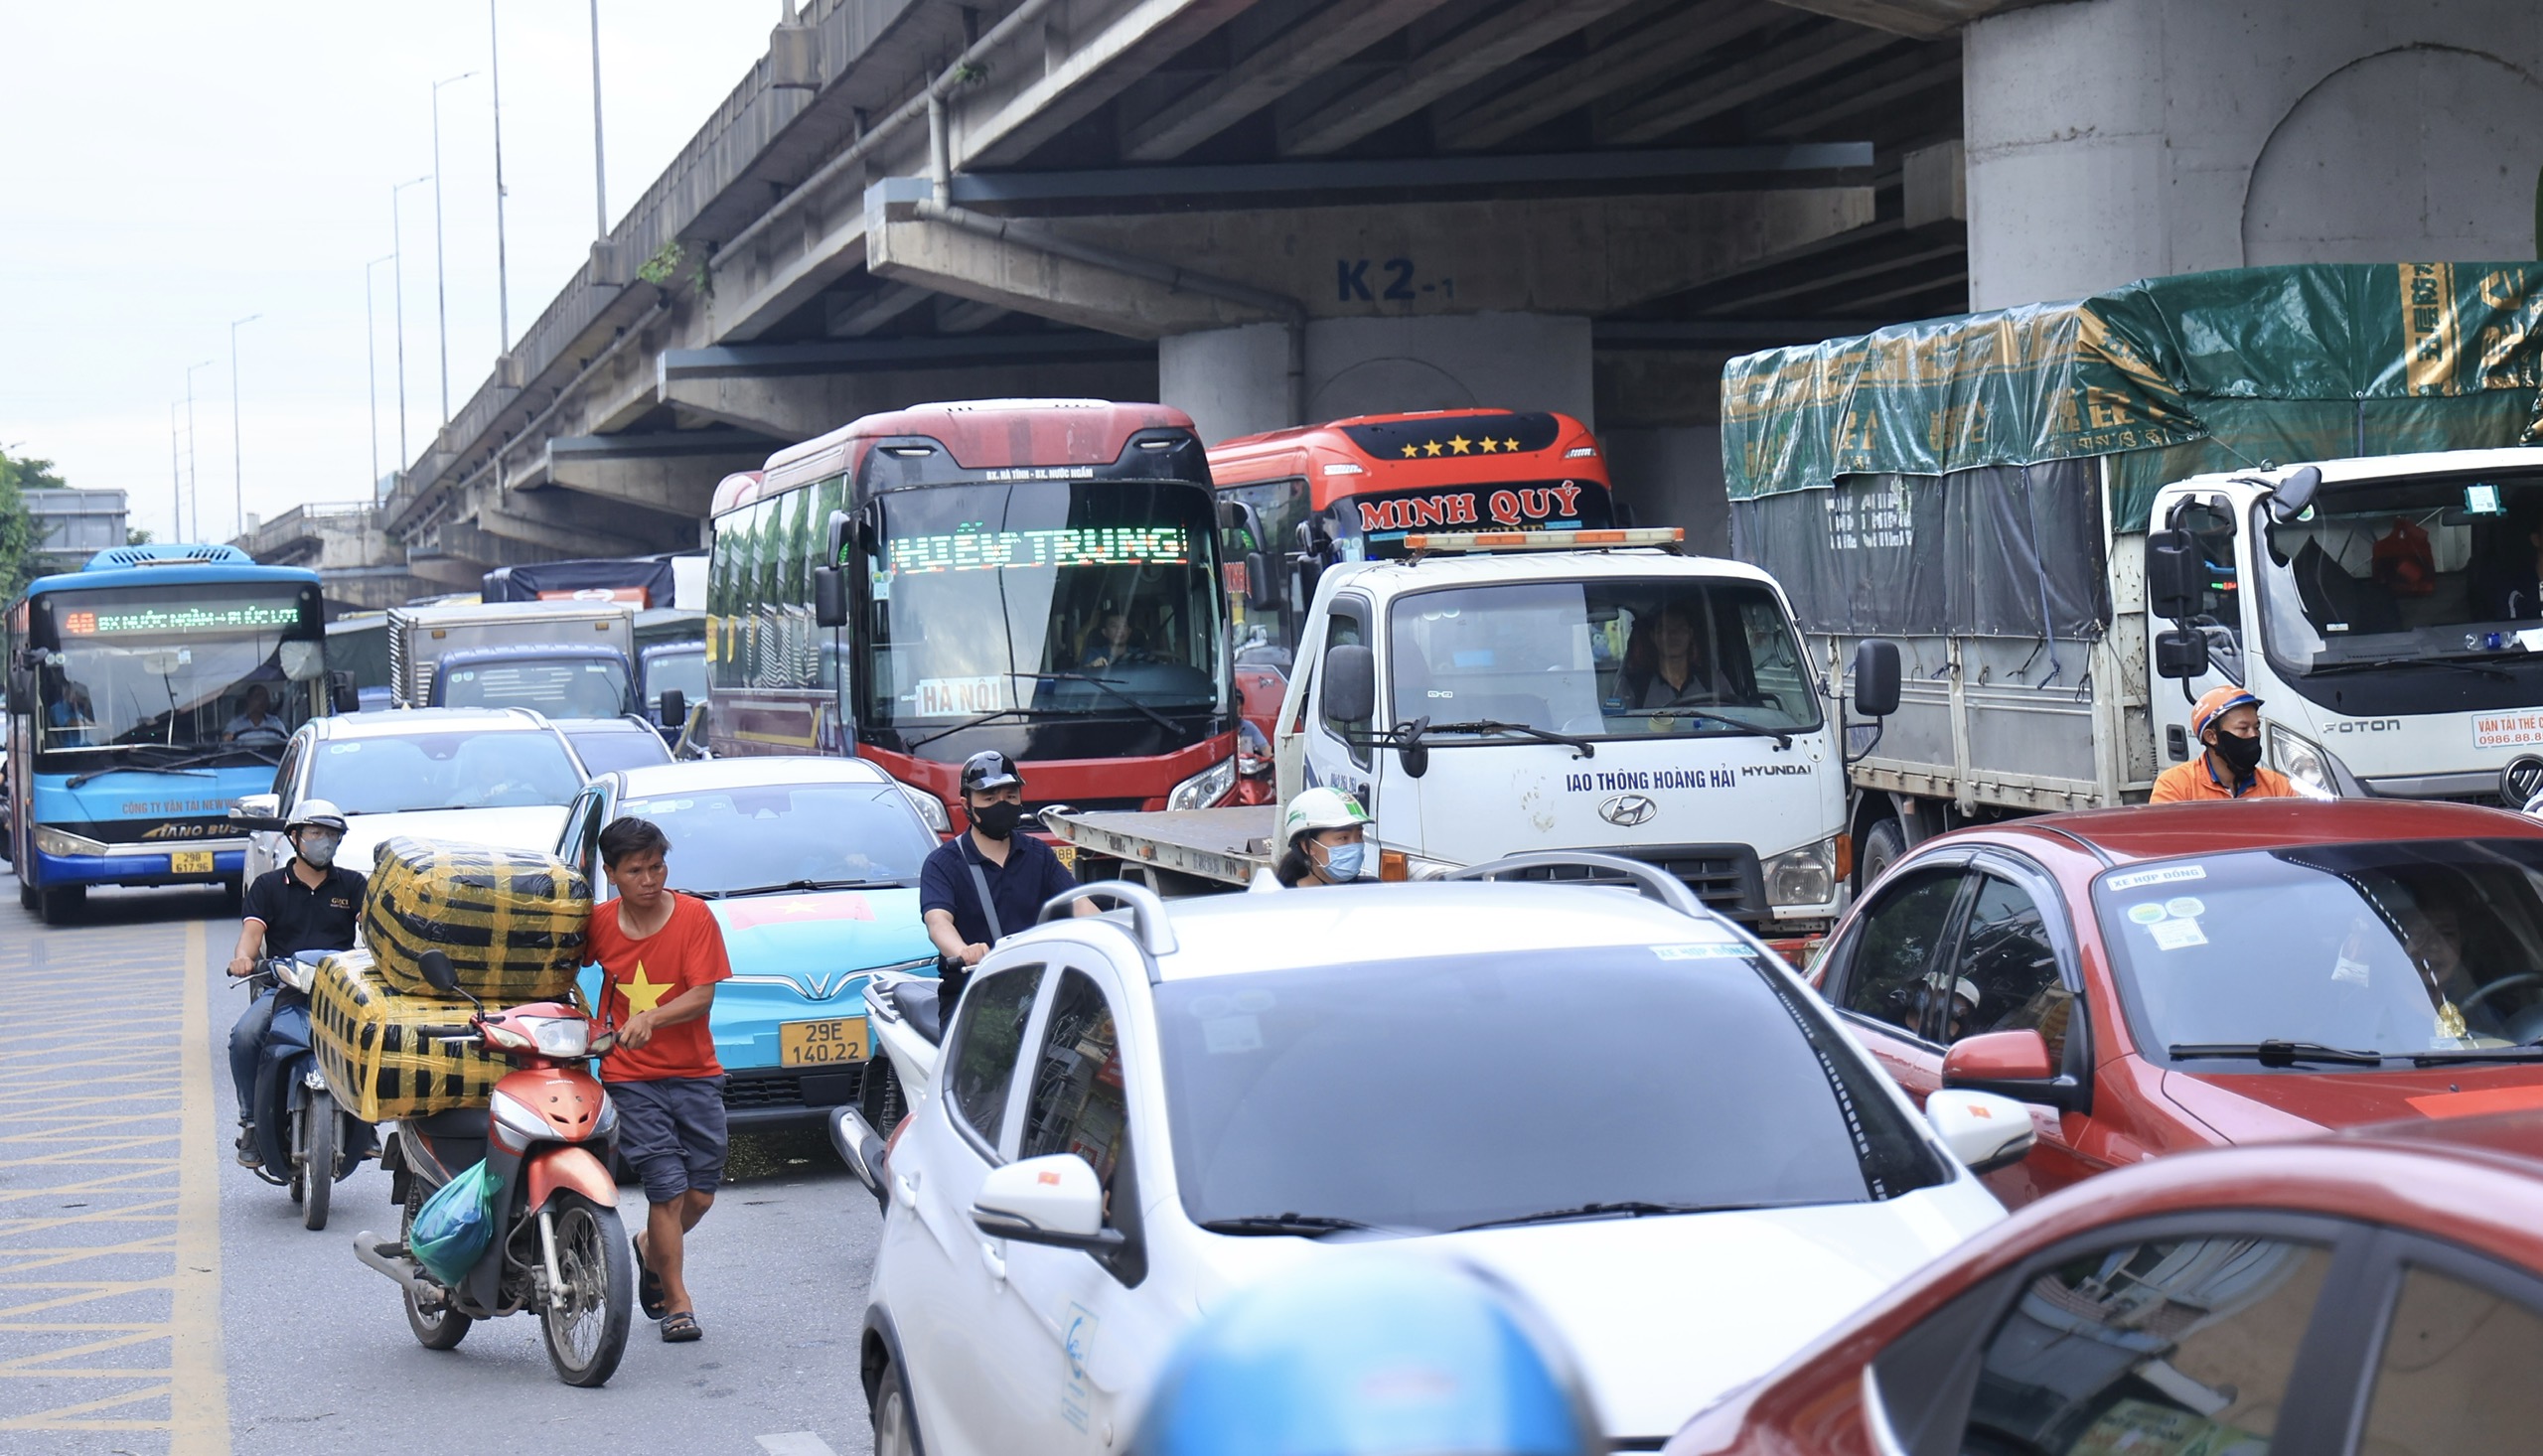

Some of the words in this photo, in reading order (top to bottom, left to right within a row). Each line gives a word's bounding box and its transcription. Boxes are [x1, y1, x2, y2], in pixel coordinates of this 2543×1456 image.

[1358, 494, 1478, 531] MINH
[1489, 480, 1581, 525] QUÝ
[1023, 527, 1180, 562] TRUNG
[923, 679, 954, 713] HÀ
[2322, 719, 2400, 733] FOTON
[2478, 717, 2498, 734] VẬN
[2500, 715, 2515, 731] TẢI
[2518, 714, 2536, 730] THẾ
[2479, 732, 2543, 745] 0986.88.8
[1596, 768, 1649, 791] THÔNG
[1654, 766, 1706, 789] HOÀNG
[1711, 763, 1736, 788] HẢI
[1741, 765, 1811, 777] HYUNDAI
[122, 801, 148, 814] CÔNG
[150, 801, 161, 812] TY
[1054, 848, 1073, 860] 8B
[2114, 878, 2130, 888] XE
[2133, 872, 2159, 884] HỢP
[806, 1022, 842, 1043] 29E
[794, 1042, 859, 1064] 140.22
